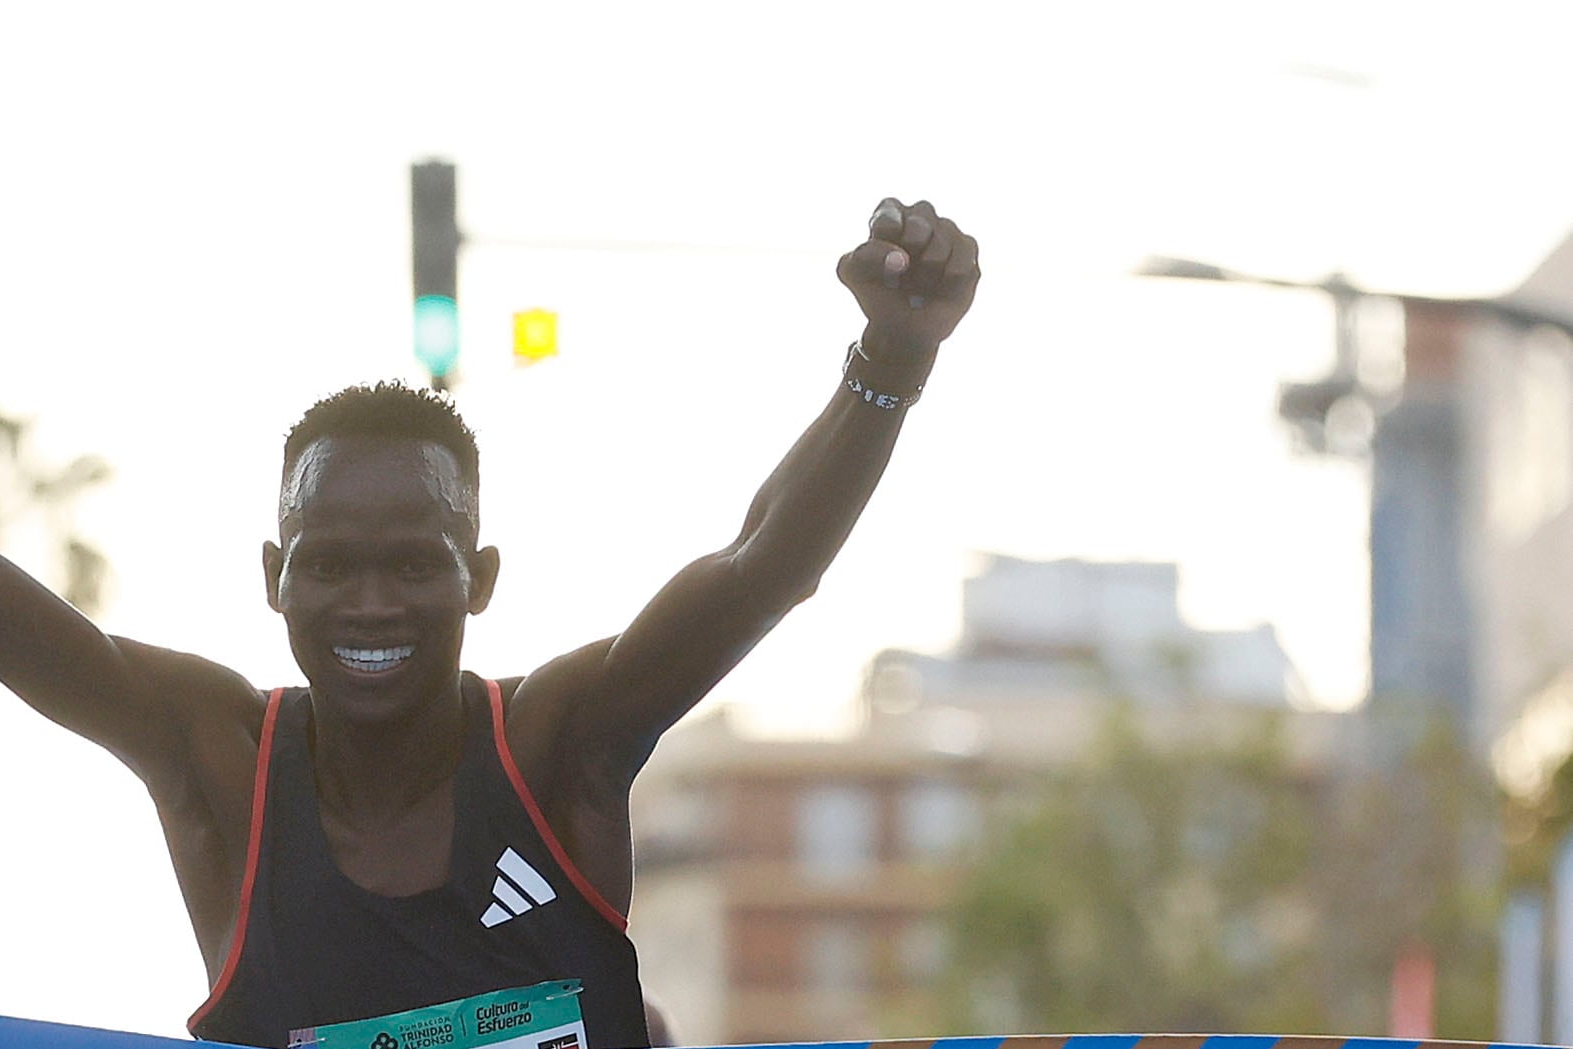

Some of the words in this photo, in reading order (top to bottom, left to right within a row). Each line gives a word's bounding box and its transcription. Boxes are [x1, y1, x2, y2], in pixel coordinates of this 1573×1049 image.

[477, 1001, 518, 1020] Cultura
[478, 1012, 532, 1034] Esfuerzo
[401, 1024, 452, 1042] TRINIDAD
